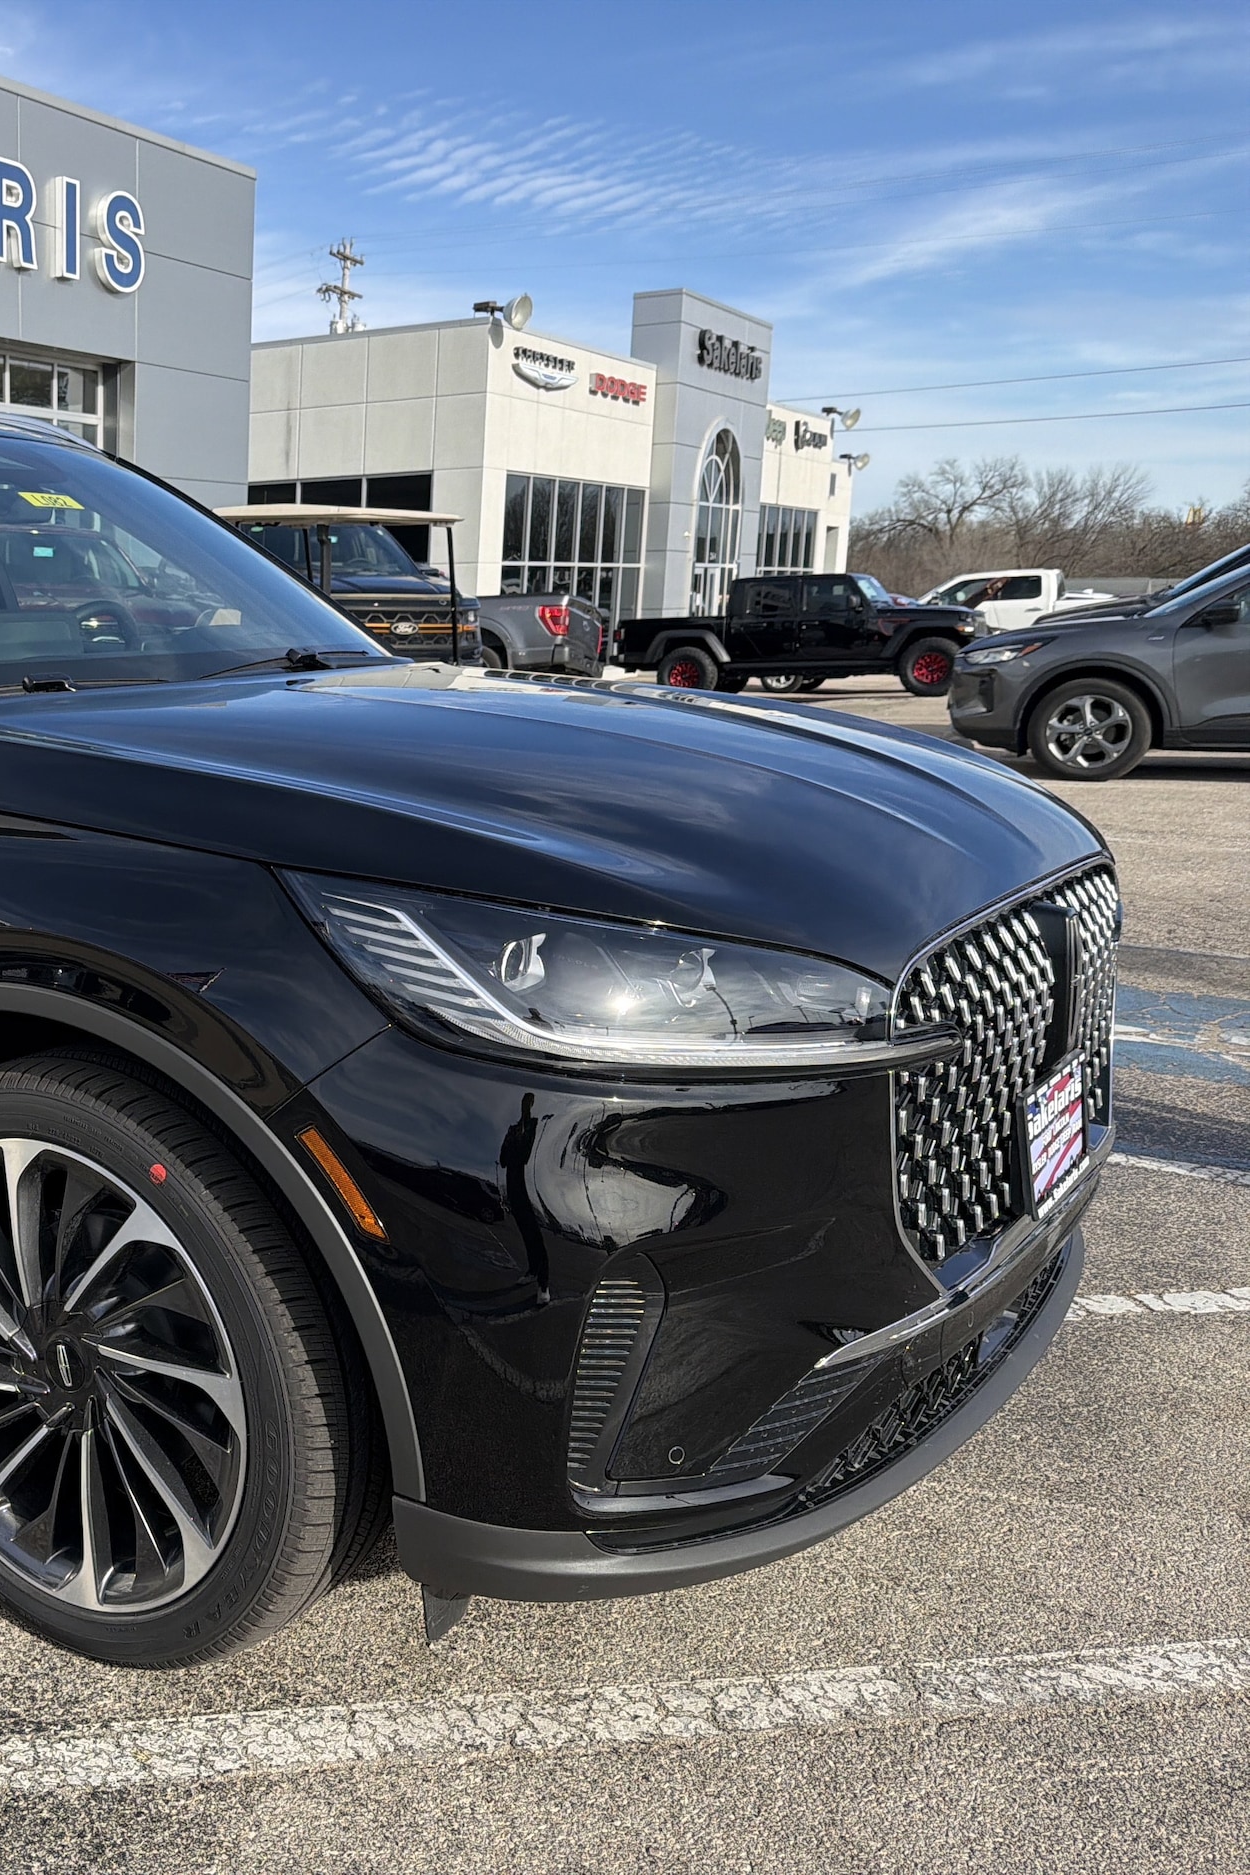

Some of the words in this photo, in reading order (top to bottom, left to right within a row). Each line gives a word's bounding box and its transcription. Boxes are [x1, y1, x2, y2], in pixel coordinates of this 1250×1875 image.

[699, 329, 763, 381] Sakelaris
[592, 373, 648, 404] DODGE
[183, 1419, 279, 1642] GOODYEAR
